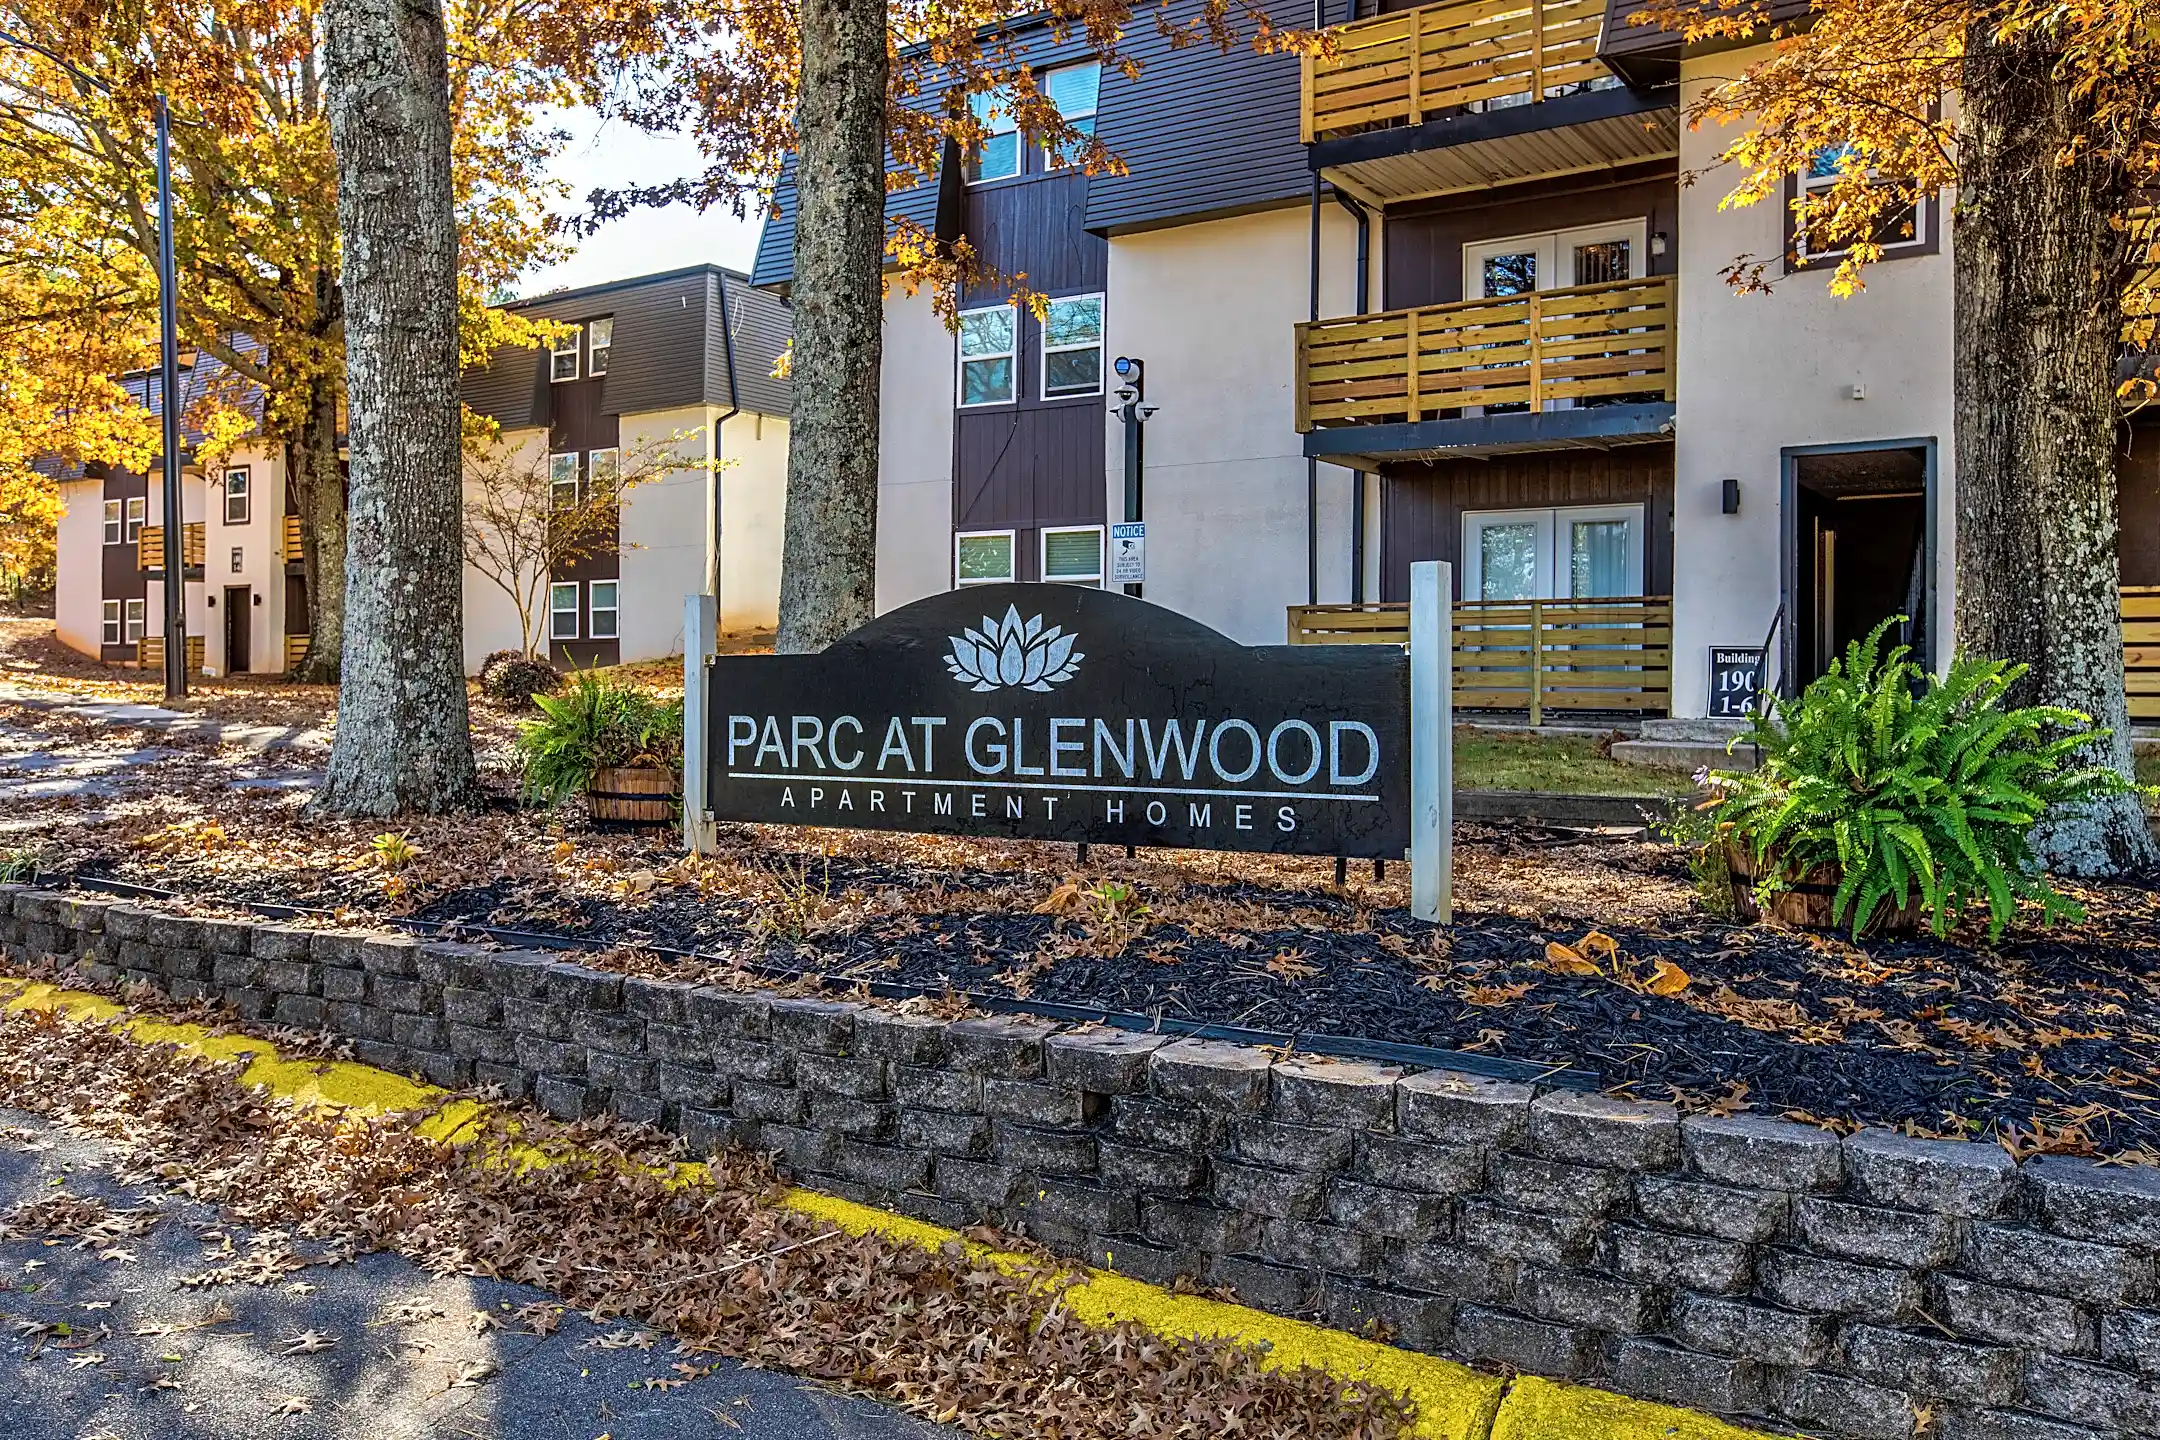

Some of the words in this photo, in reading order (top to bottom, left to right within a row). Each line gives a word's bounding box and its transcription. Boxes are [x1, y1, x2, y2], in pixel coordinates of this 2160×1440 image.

[1114, 525, 1144, 537] NOTICE
[1717, 653, 1760, 666] Building
[727, 715, 865, 770] PARC
[876, 716, 947, 773] AT
[964, 716, 1380, 786] GLENWOOD
[780, 786, 1059, 821] APARTMENT
[1106, 799, 1297, 832] HOMES
